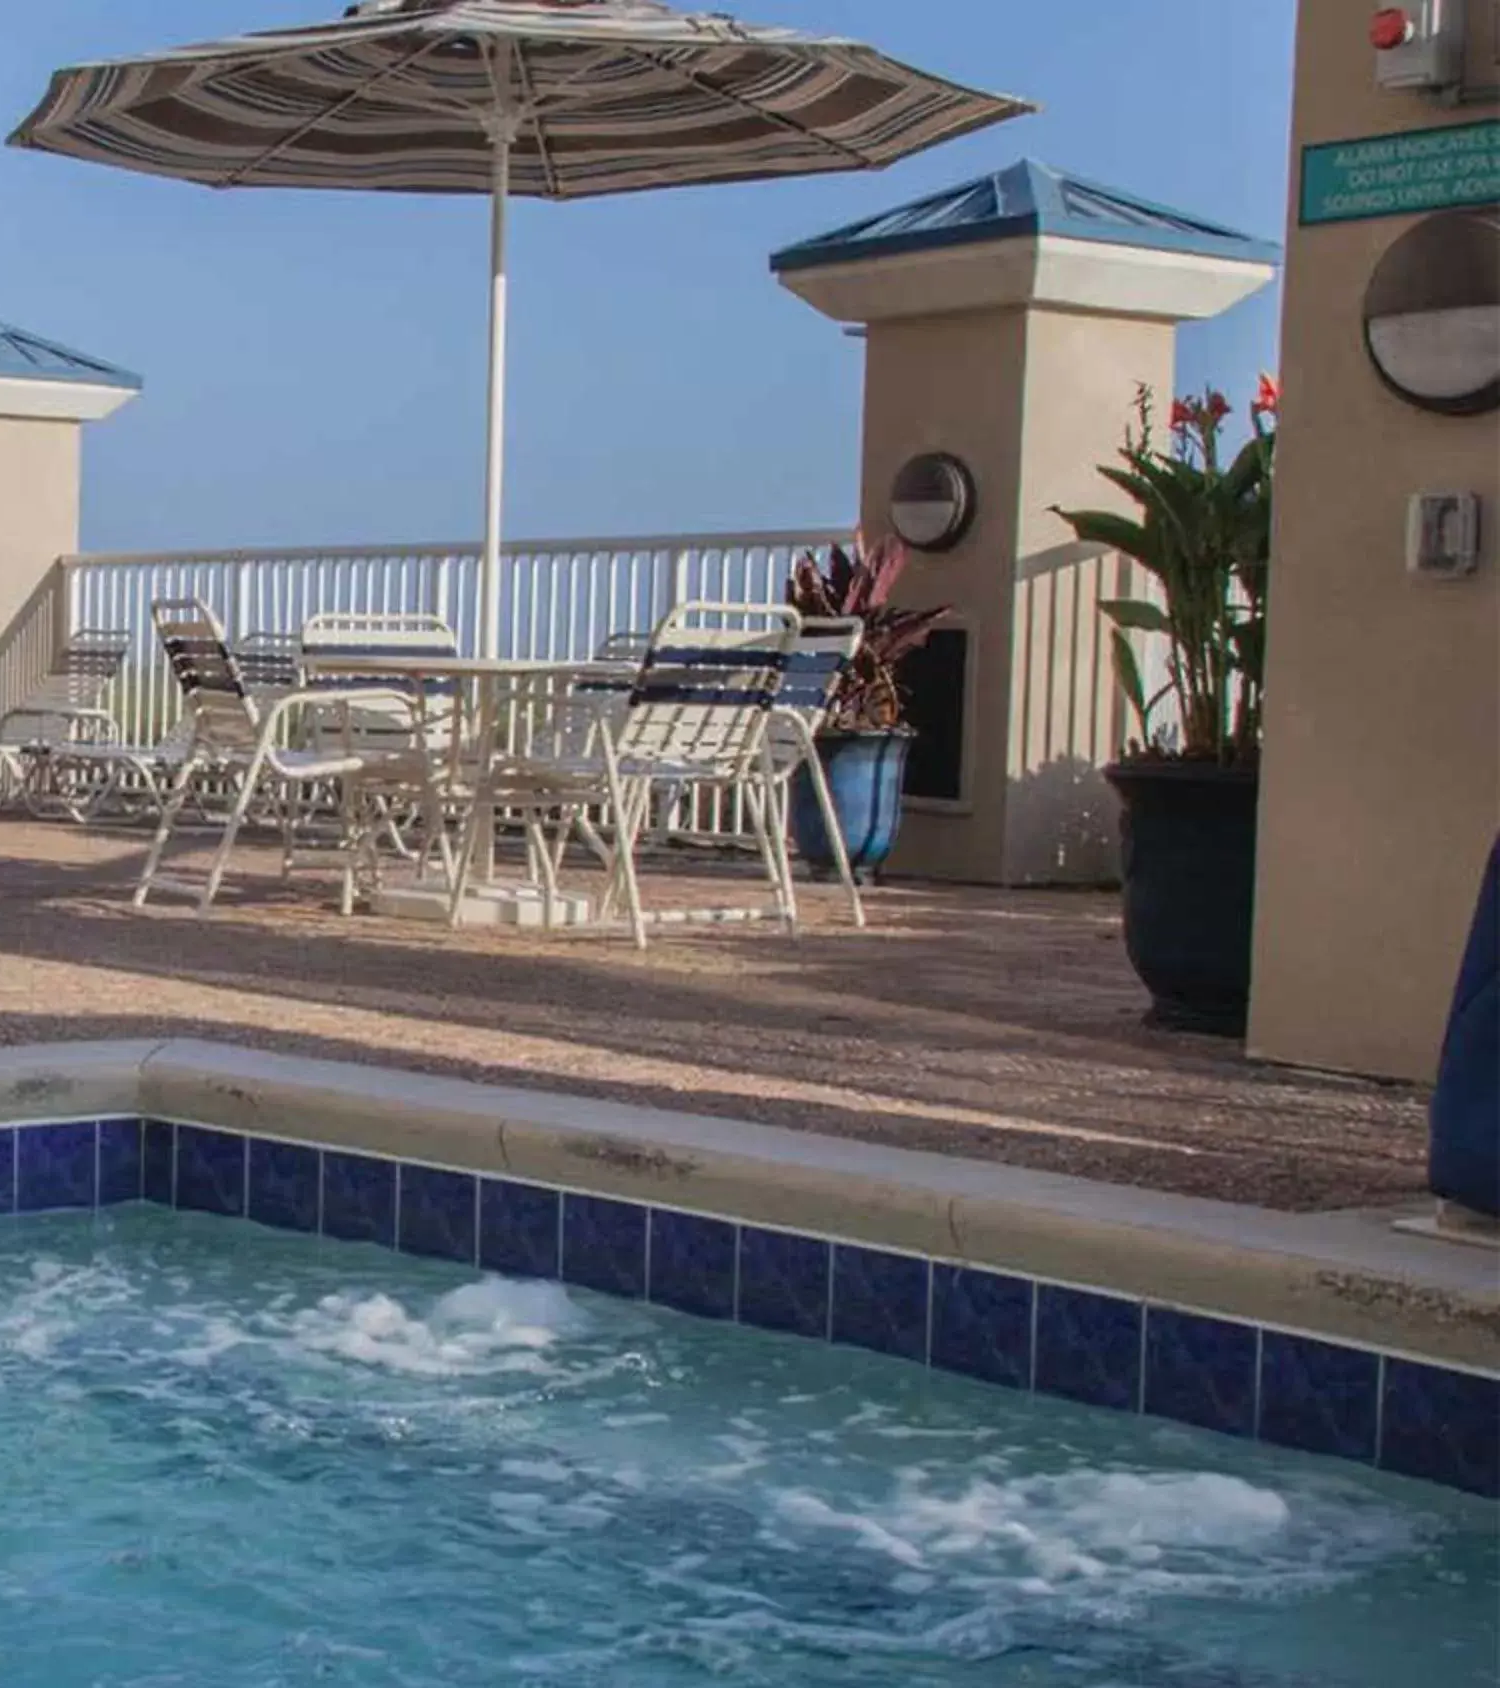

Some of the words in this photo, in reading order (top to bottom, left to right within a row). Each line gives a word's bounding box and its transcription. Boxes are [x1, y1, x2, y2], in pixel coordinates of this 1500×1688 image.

[1349, 169, 1376, 189] DO
[1381, 164, 1414, 185] NOT
[1420, 160, 1451, 180] USE
